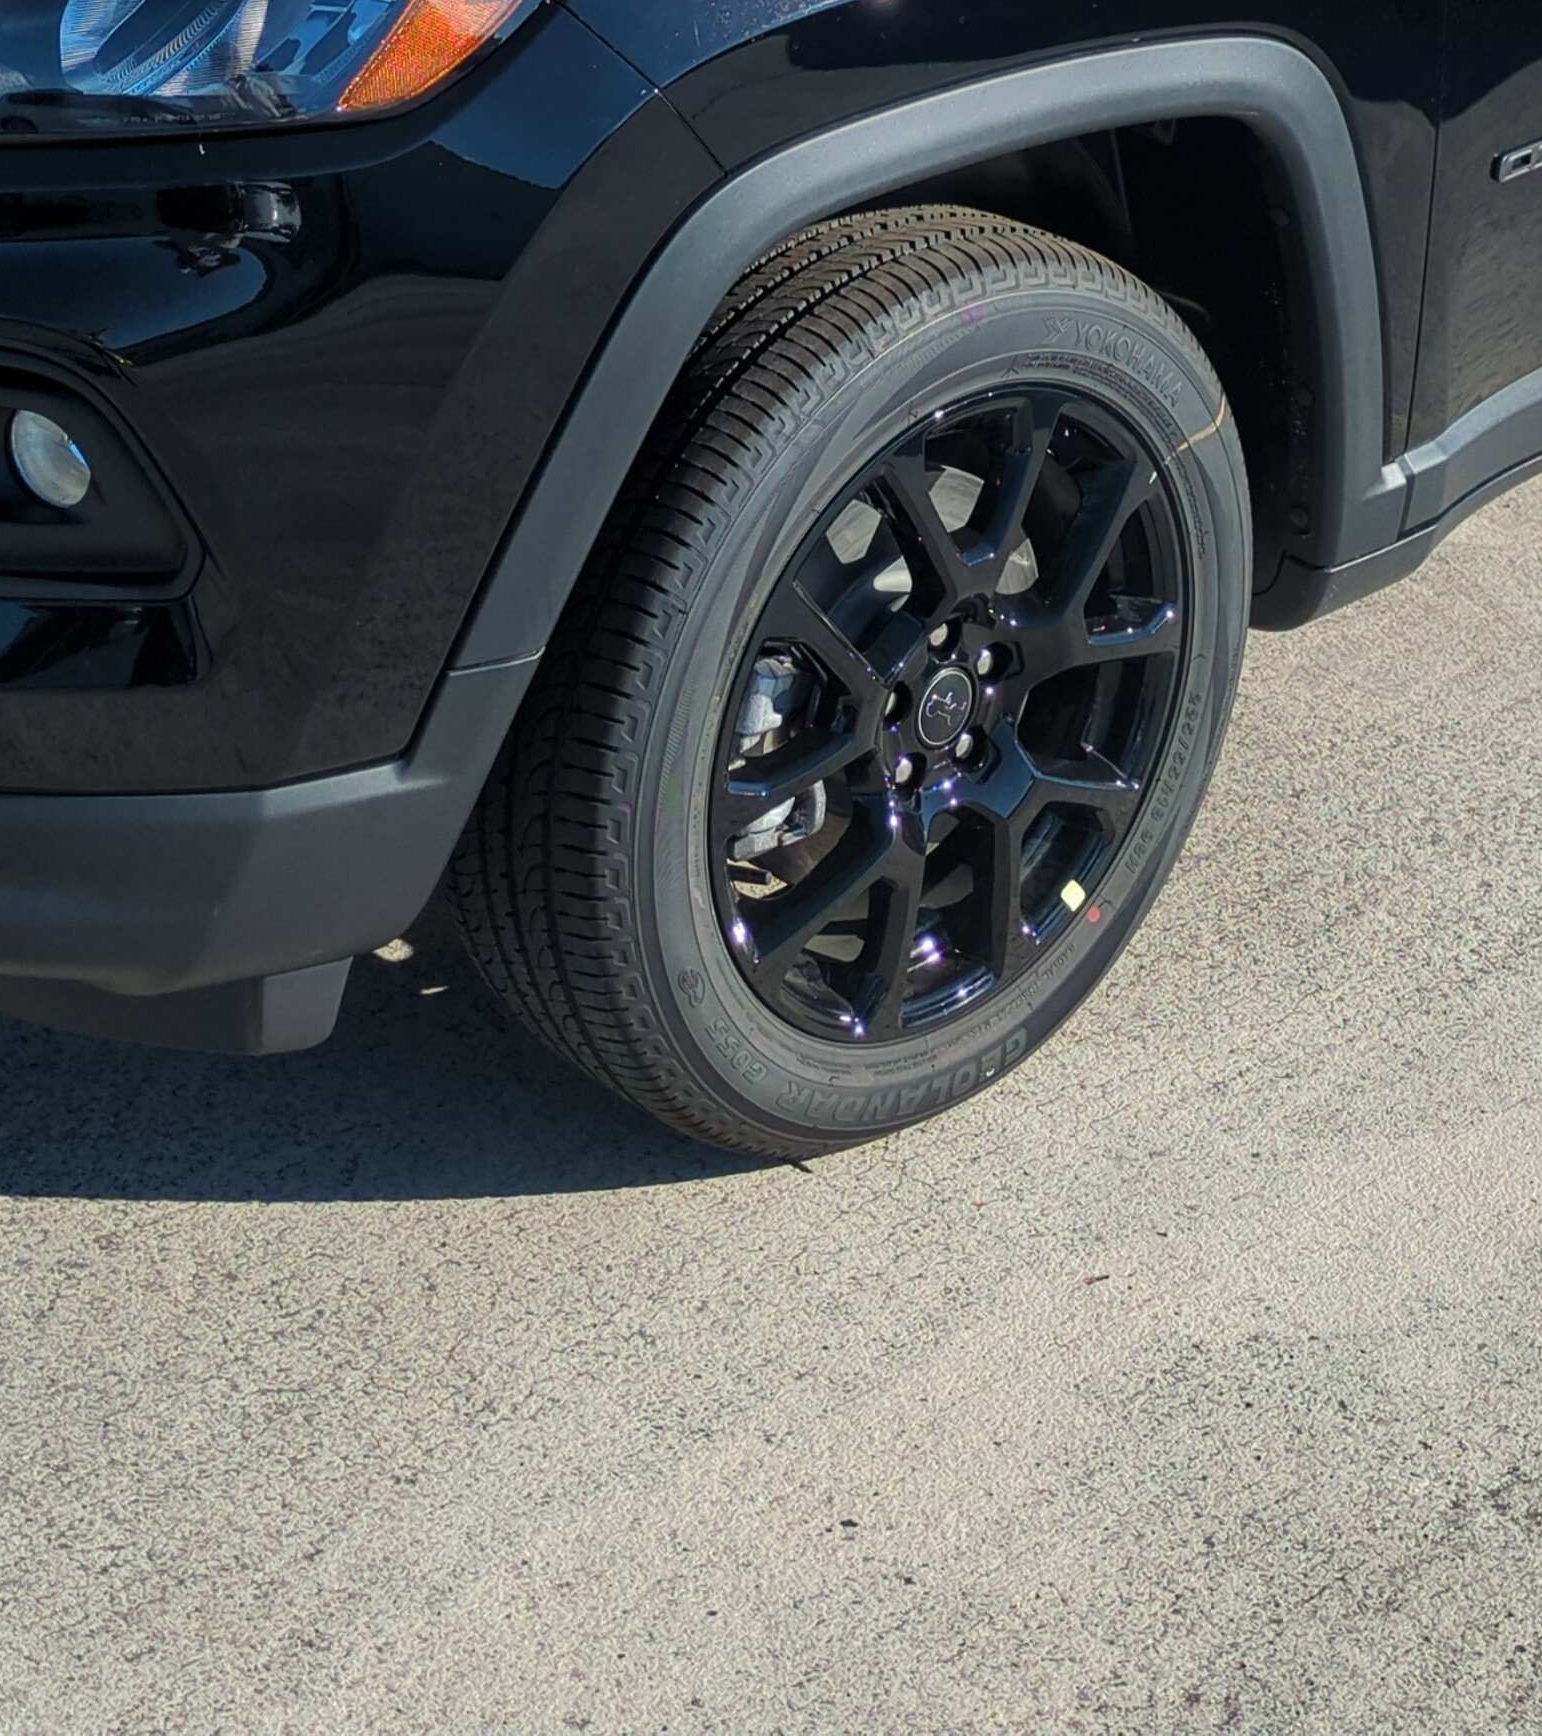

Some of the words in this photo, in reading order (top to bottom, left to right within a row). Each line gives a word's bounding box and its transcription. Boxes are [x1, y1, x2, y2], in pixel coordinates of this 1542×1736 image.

[1073, 319, 1183, 409] YOKOHAMA
[705, 1016, 770, 1085] G055
[775, 1027, 1028, 1123] GEOLANDAR
